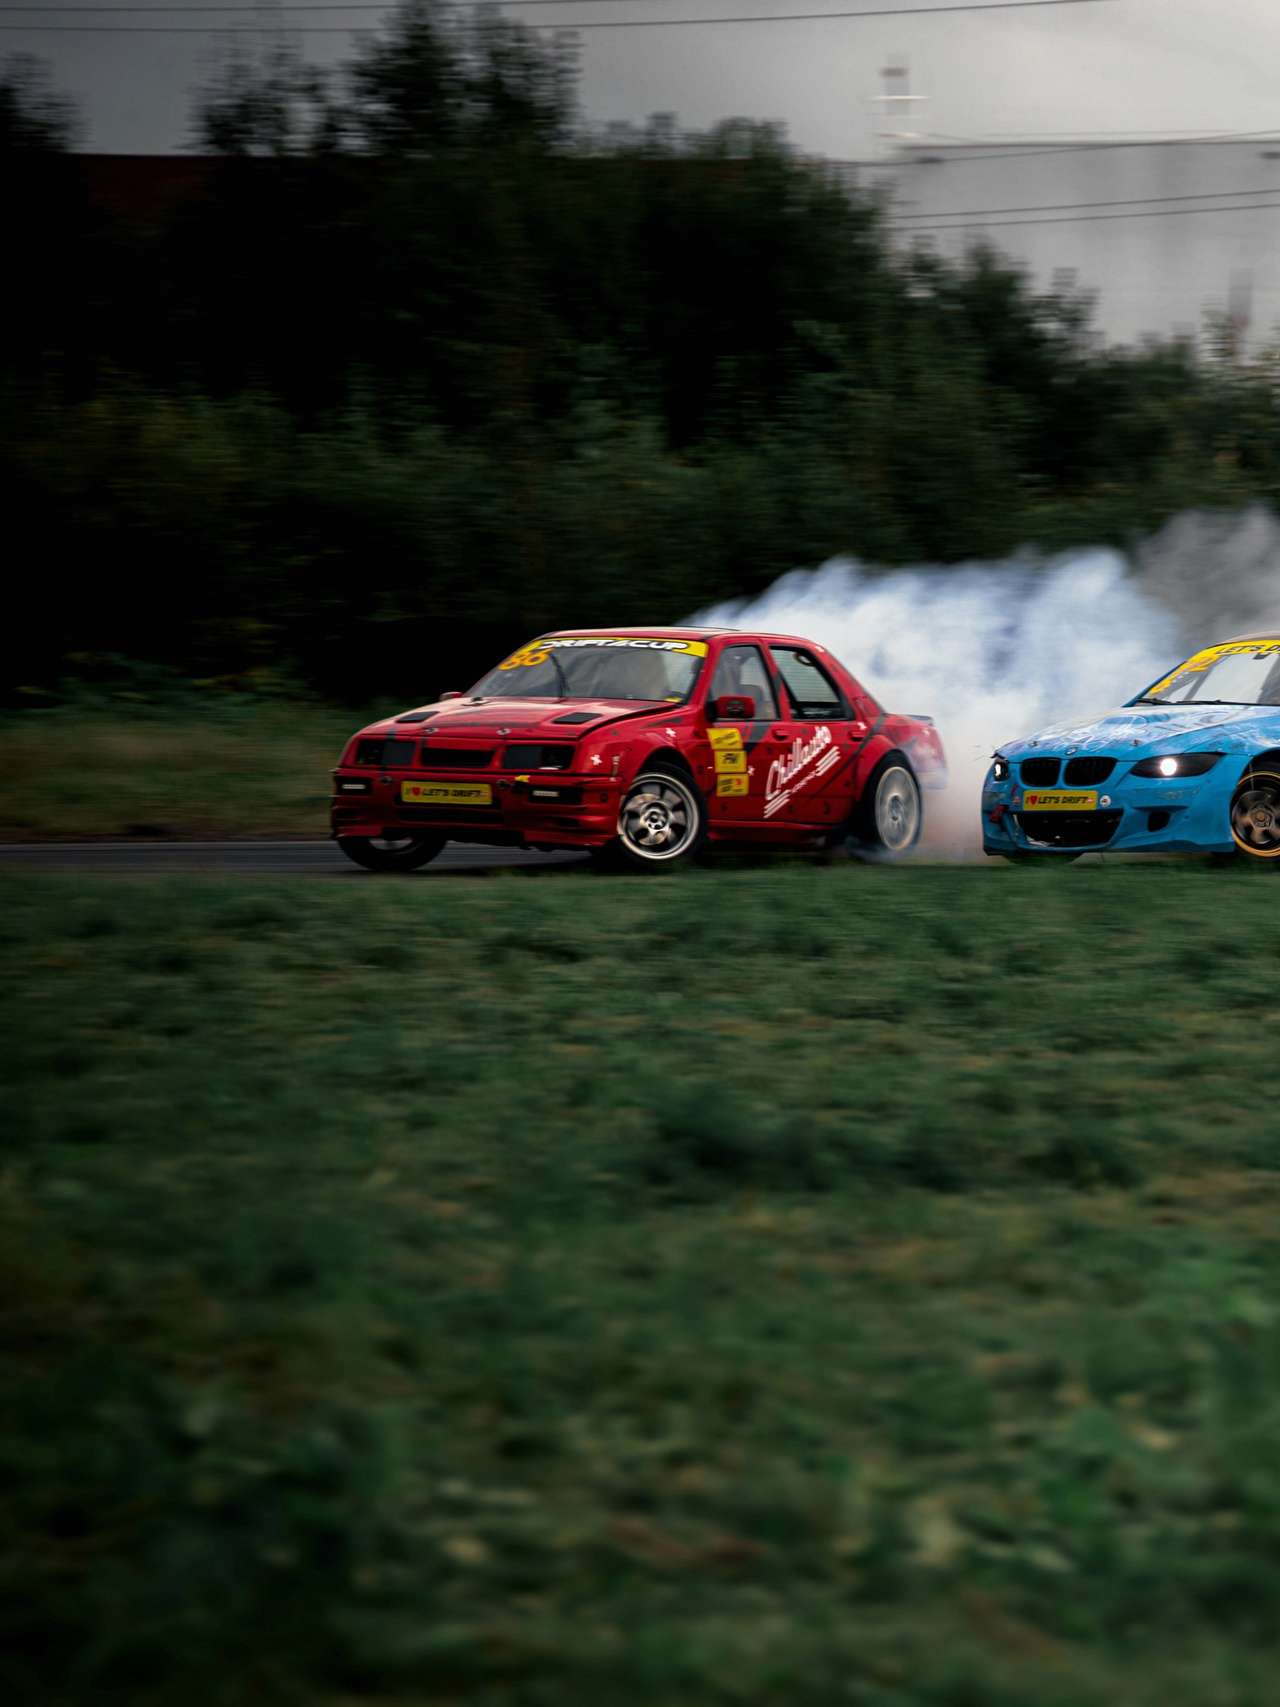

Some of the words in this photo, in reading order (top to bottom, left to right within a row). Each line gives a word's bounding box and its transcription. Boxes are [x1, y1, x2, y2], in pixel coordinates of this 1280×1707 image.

[1214, 644, 1266, 654] LET'S
[450, 789, 481, 798] DRIFT
[1025, 796, 1031, 804] I
[1038, 796, 1060, 804] LET'S
[1061, 796, 1088, 804] DRIFT
